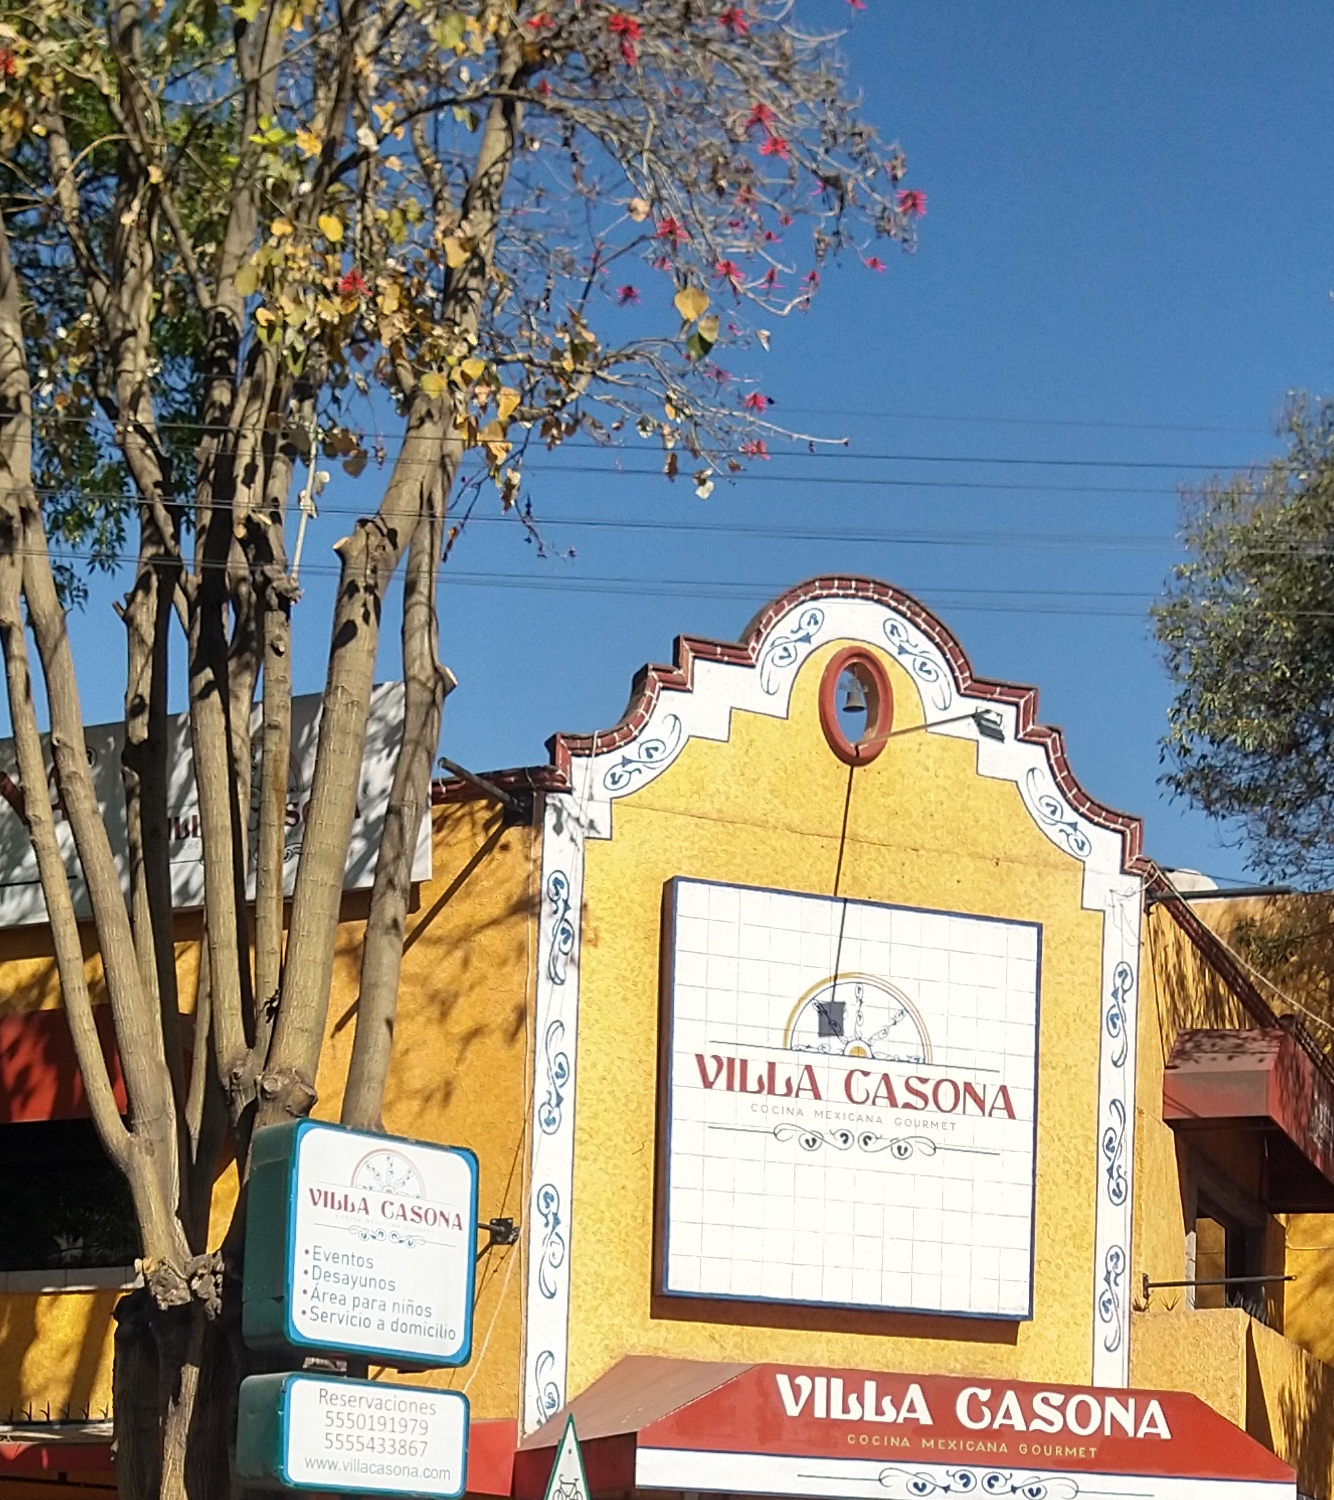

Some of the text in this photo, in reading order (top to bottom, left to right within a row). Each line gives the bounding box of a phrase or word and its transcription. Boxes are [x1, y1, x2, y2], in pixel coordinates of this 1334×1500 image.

[695, 1053, 1017, 1120] VILLA CASONA
[750, 1103, 957, 1132] COCINA MEXICANA GOURMET
[308, 1187, 370, 1216] VILLA
[380, 1199, 463, 1232] CASONA
[312, 1245, 374, 1269] Eventos
[312, 1264, 396, 1292] Desayunos
[310, 1283, 433, 1318] Área para niños
[309, 1305, 457, 1341] Servicio a domicilio
[318, 1387, 437, 1416] Reservaciones
[775, 1373, 1173, 1440] VILLA CASONA
[324, 1410, 429, 1436] 5550191979
[324, 1432, 429, 1458] 5555433867
[847, 1433, 1098, 1459] COCINA MEXICANA GOURMET
[304, 1456, 451, 1481] www.villacasona.com
